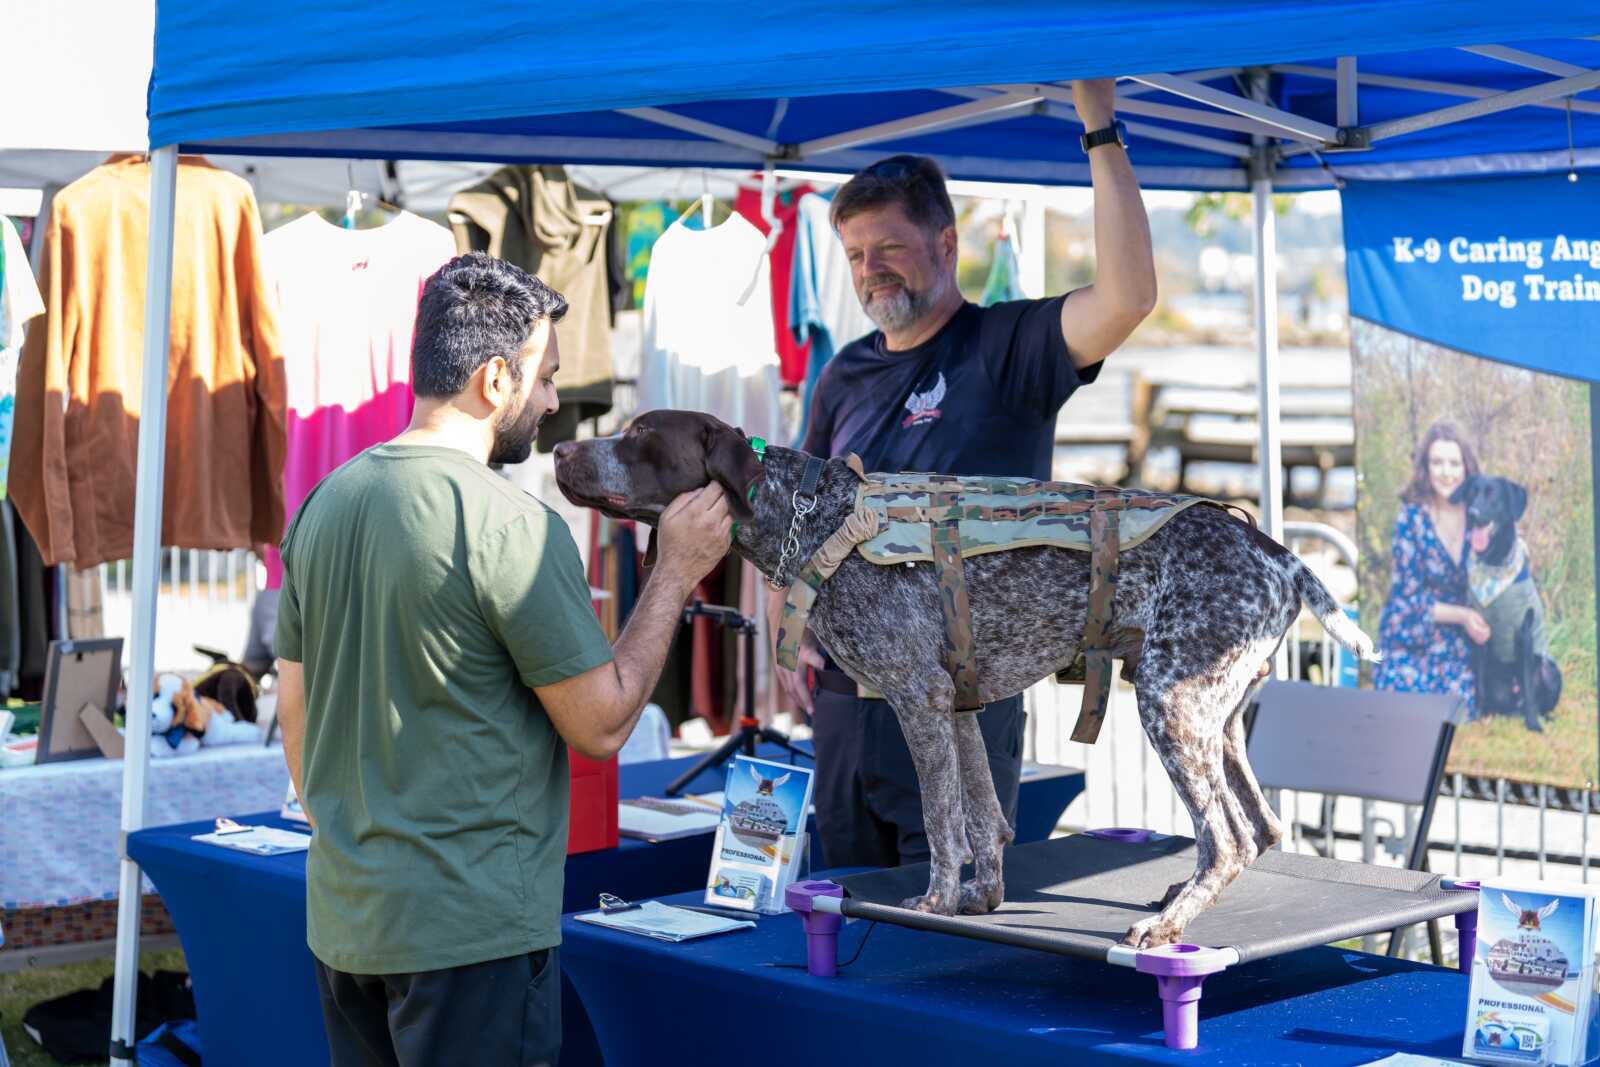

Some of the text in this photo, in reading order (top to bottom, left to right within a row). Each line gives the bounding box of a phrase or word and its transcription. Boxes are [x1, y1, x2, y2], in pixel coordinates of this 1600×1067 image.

[1393, 237, 1441, 263] K-9
[1449, 236, 1543, 269] Caring
[1461, 275, 1517, 308] Dog
[721, 847, 767, 863] PROFESSIONAL
[1478, 998, 1545, 1014] PROFESSIONAL
